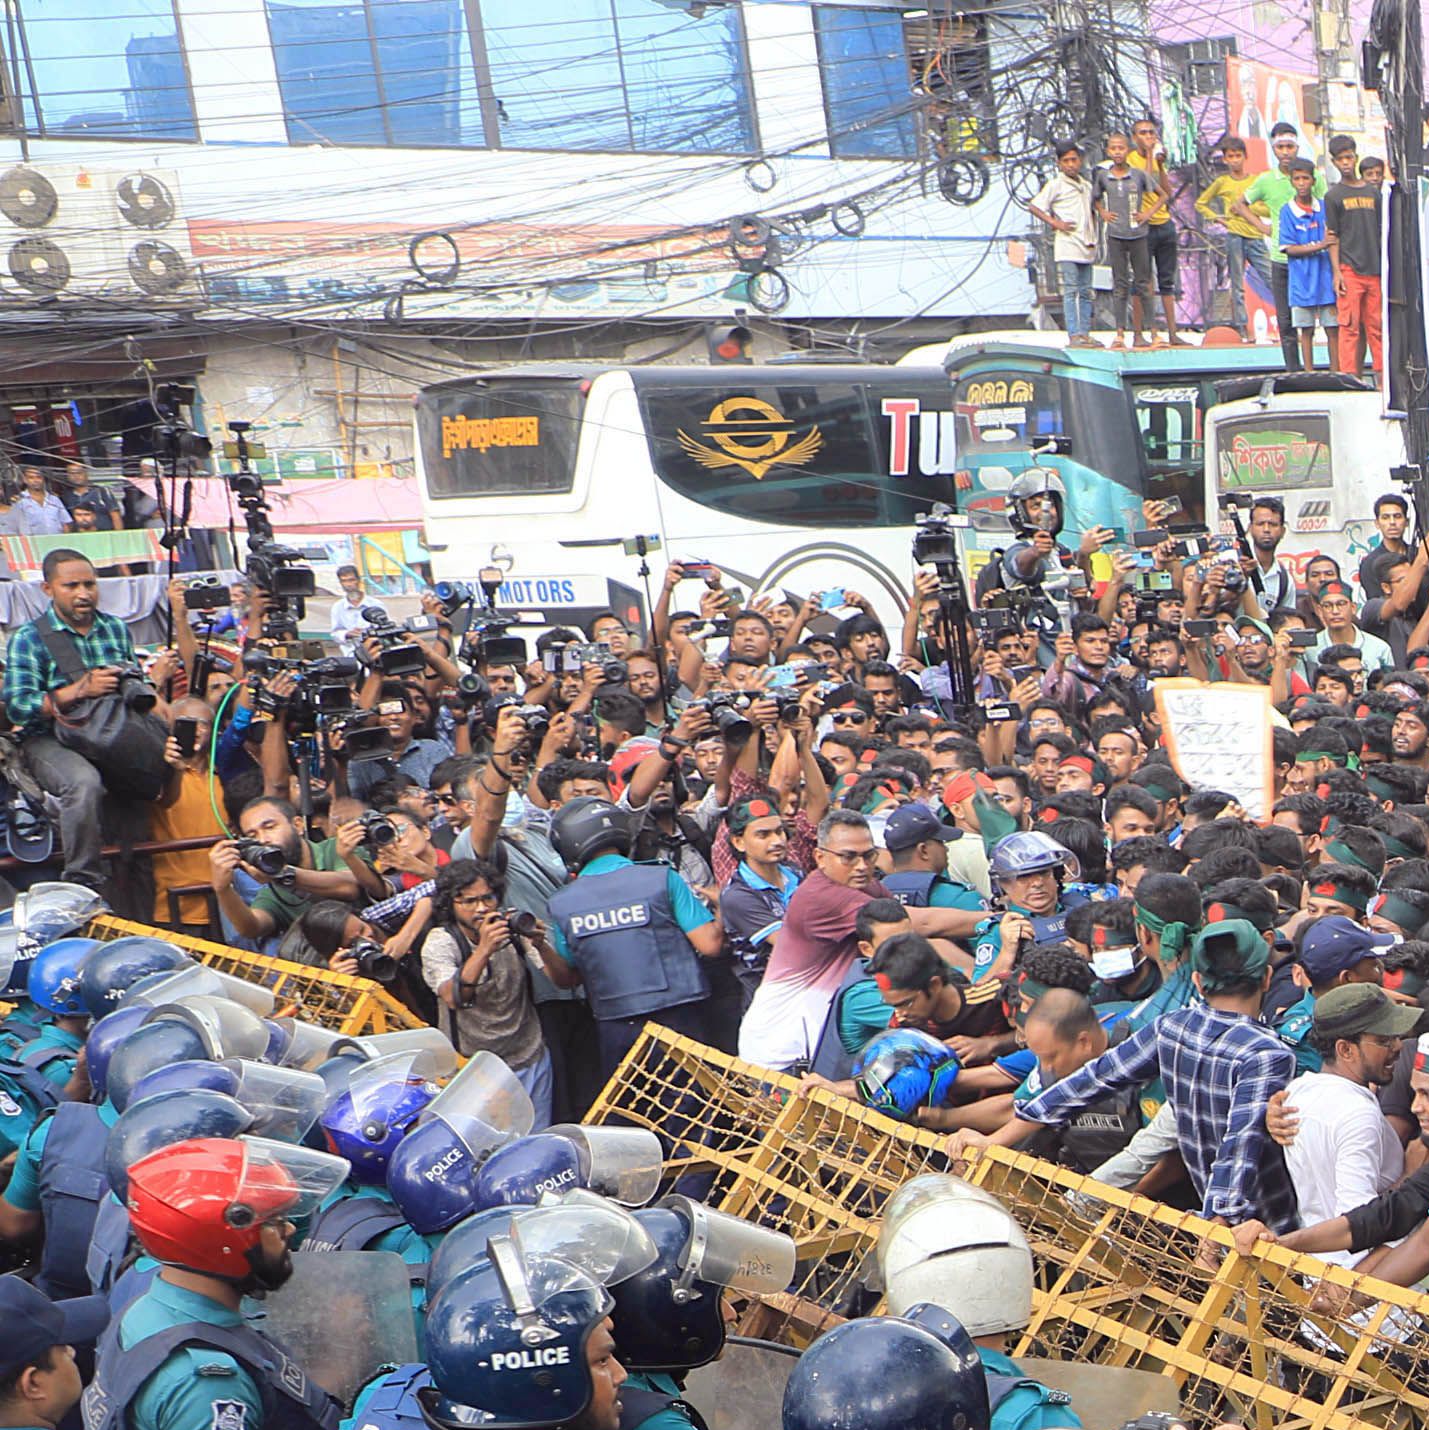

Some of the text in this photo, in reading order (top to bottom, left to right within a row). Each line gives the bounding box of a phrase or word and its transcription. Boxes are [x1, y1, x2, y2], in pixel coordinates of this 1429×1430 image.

[500, 579, 575, 605] MOTORS
[570, 904, 647, 935] POLICE
[425, 1147, 465, 1183] POLICE
[535, 1167, 578, 1196] POLICE
[491, 1346, 570, 1371] POLICE
